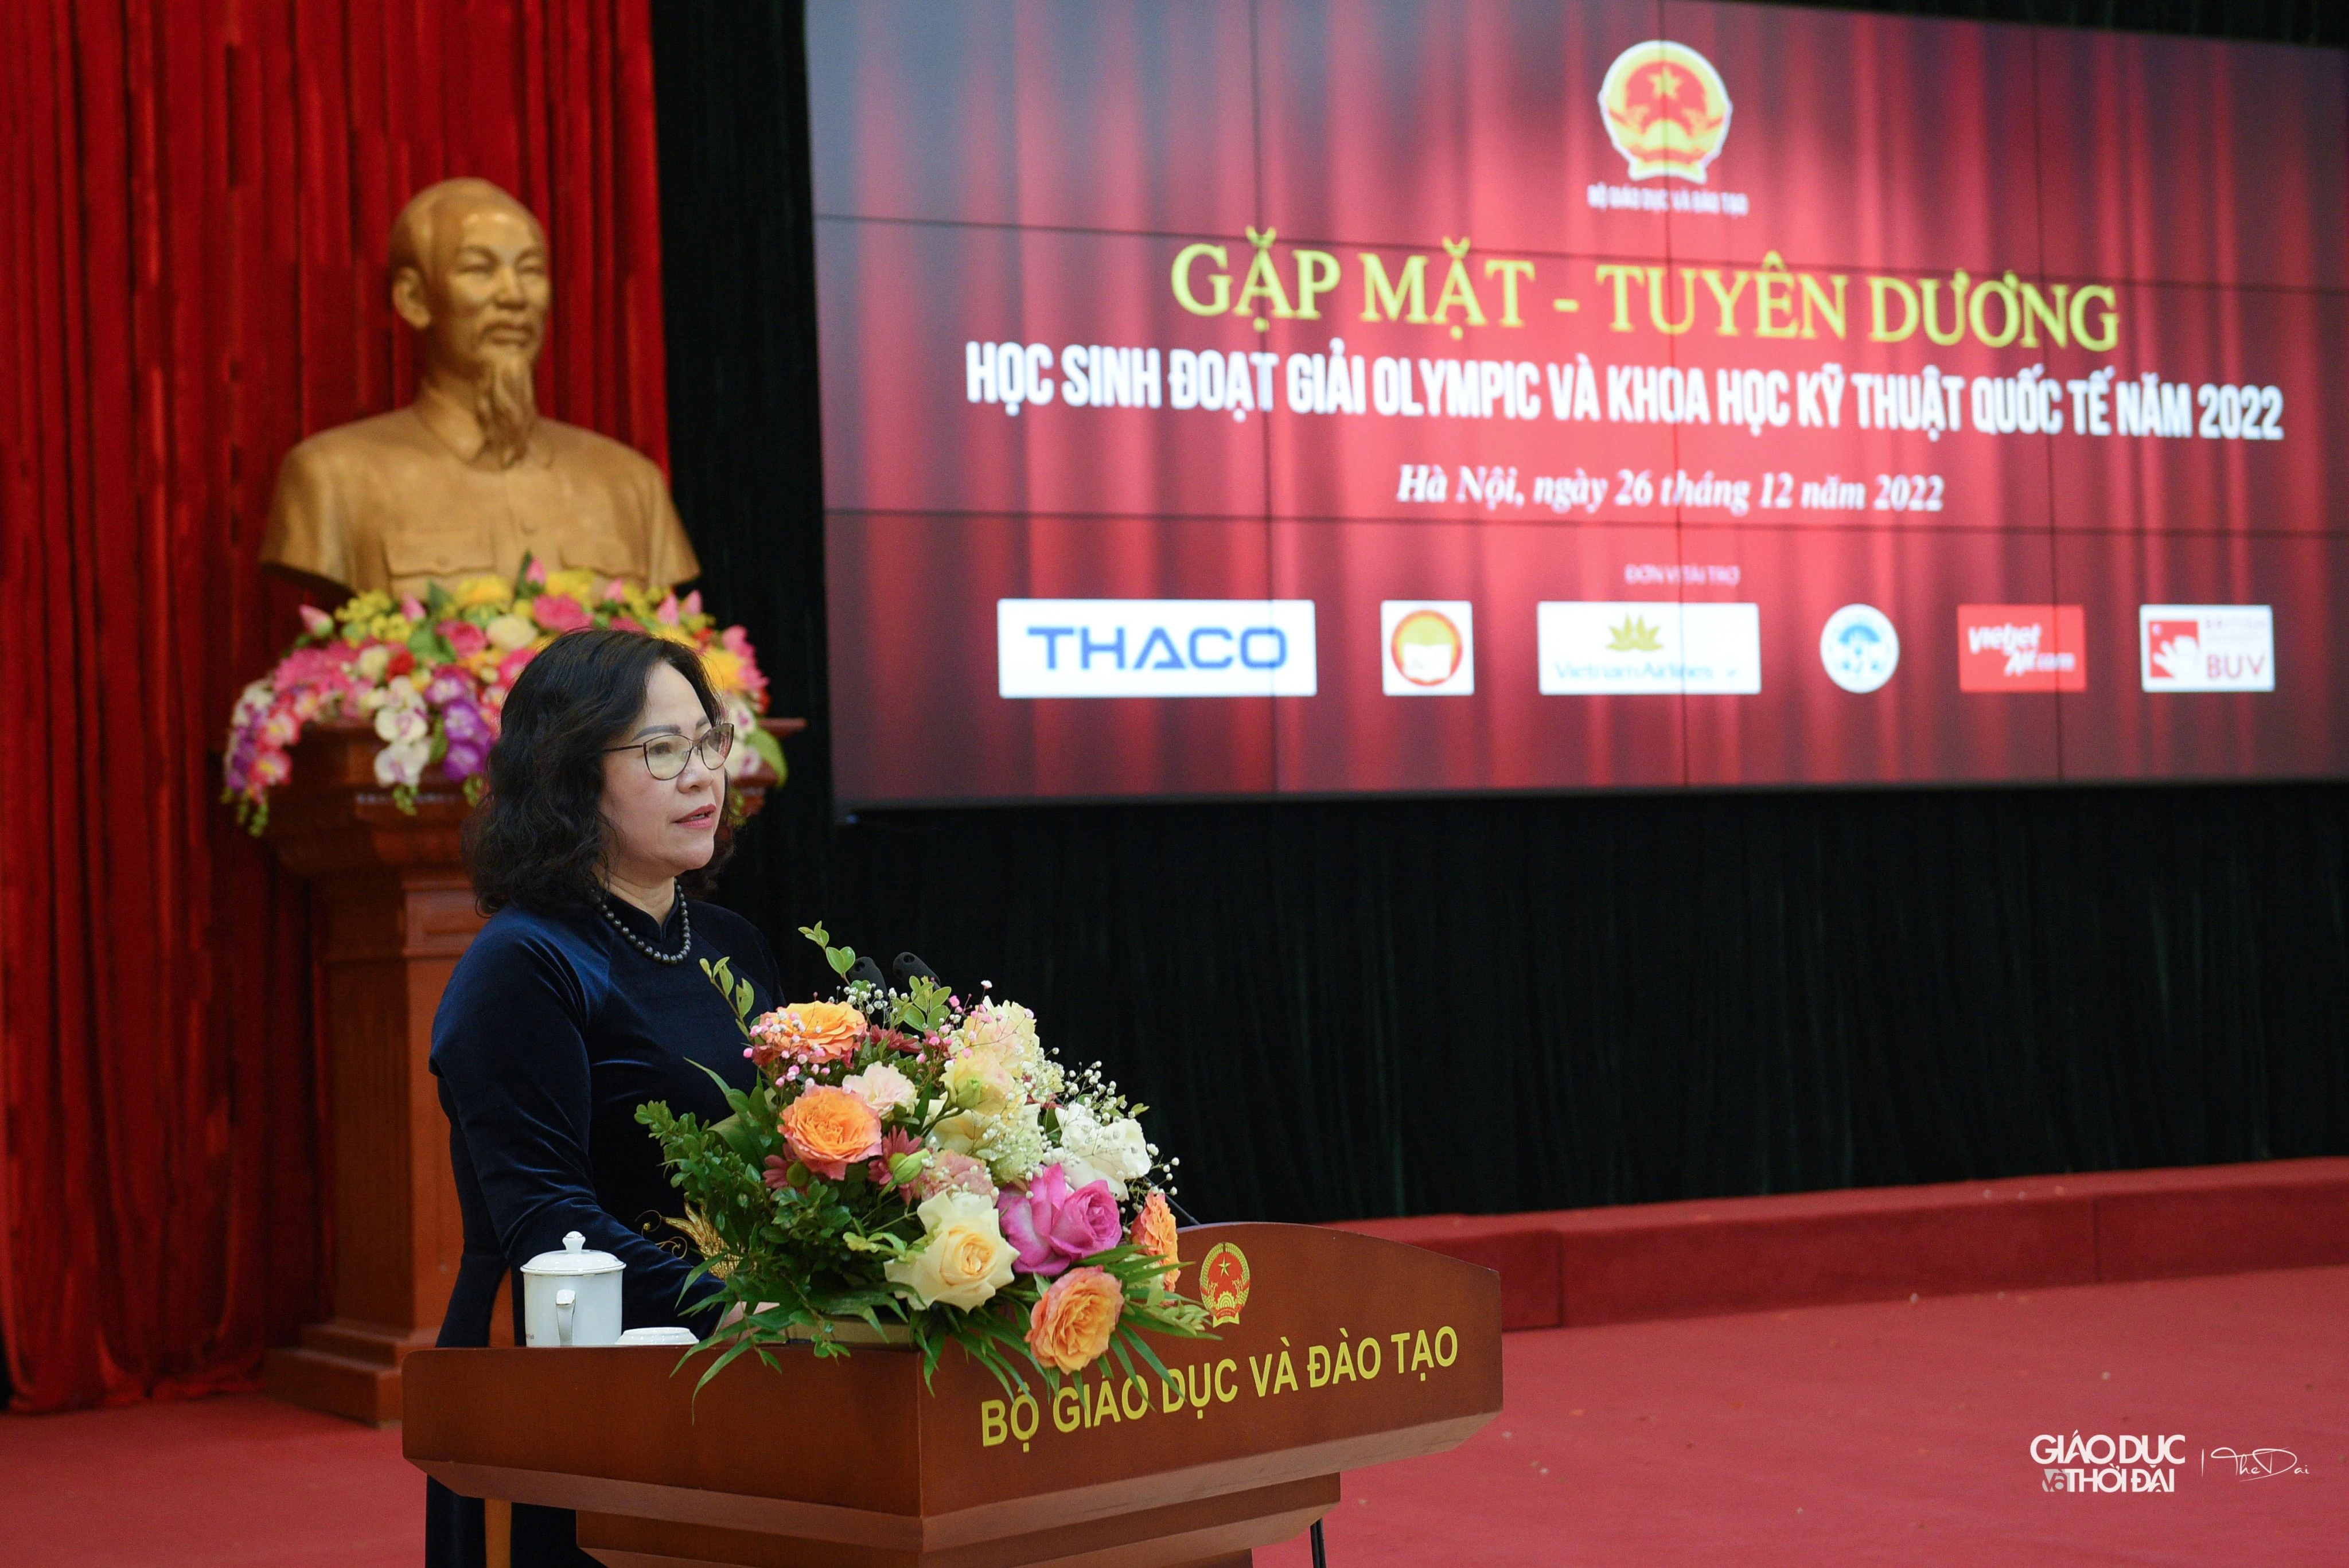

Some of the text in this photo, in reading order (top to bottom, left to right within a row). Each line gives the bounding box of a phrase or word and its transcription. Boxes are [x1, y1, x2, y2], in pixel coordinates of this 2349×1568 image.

[1171, 226, 1340, 331] GẶP
[1359, 236, 1534, 339] MẶT
[1596, 251, 1848, 340] TUYÊN
[1868, 269, 2119, 351] DƯƠNG
[966, 337, 2284, 441] HỌC SINH ĐOẠT GIẢI OLYMPIC VÀ KHOA HỌC KỸ THUẬT QUỐC TẾ NĂM 2022
[1397, 464, 1945, 516] Hà Nội, ngày 26 tháng 12 năm 2022
[1026, 626, 1288, 670] THACO
[2206, 653, 2266, 680] BUV
[981, 1382, 1039, 1453] BỘ
[1162, 1358, 1238, 1419] DỤC
[1249, 1336, 1299, 1398] VÀ
[1307, 1327, 1381, 1388] ĐÀO
[1390, 1326, 1458, 1382] TẠO
